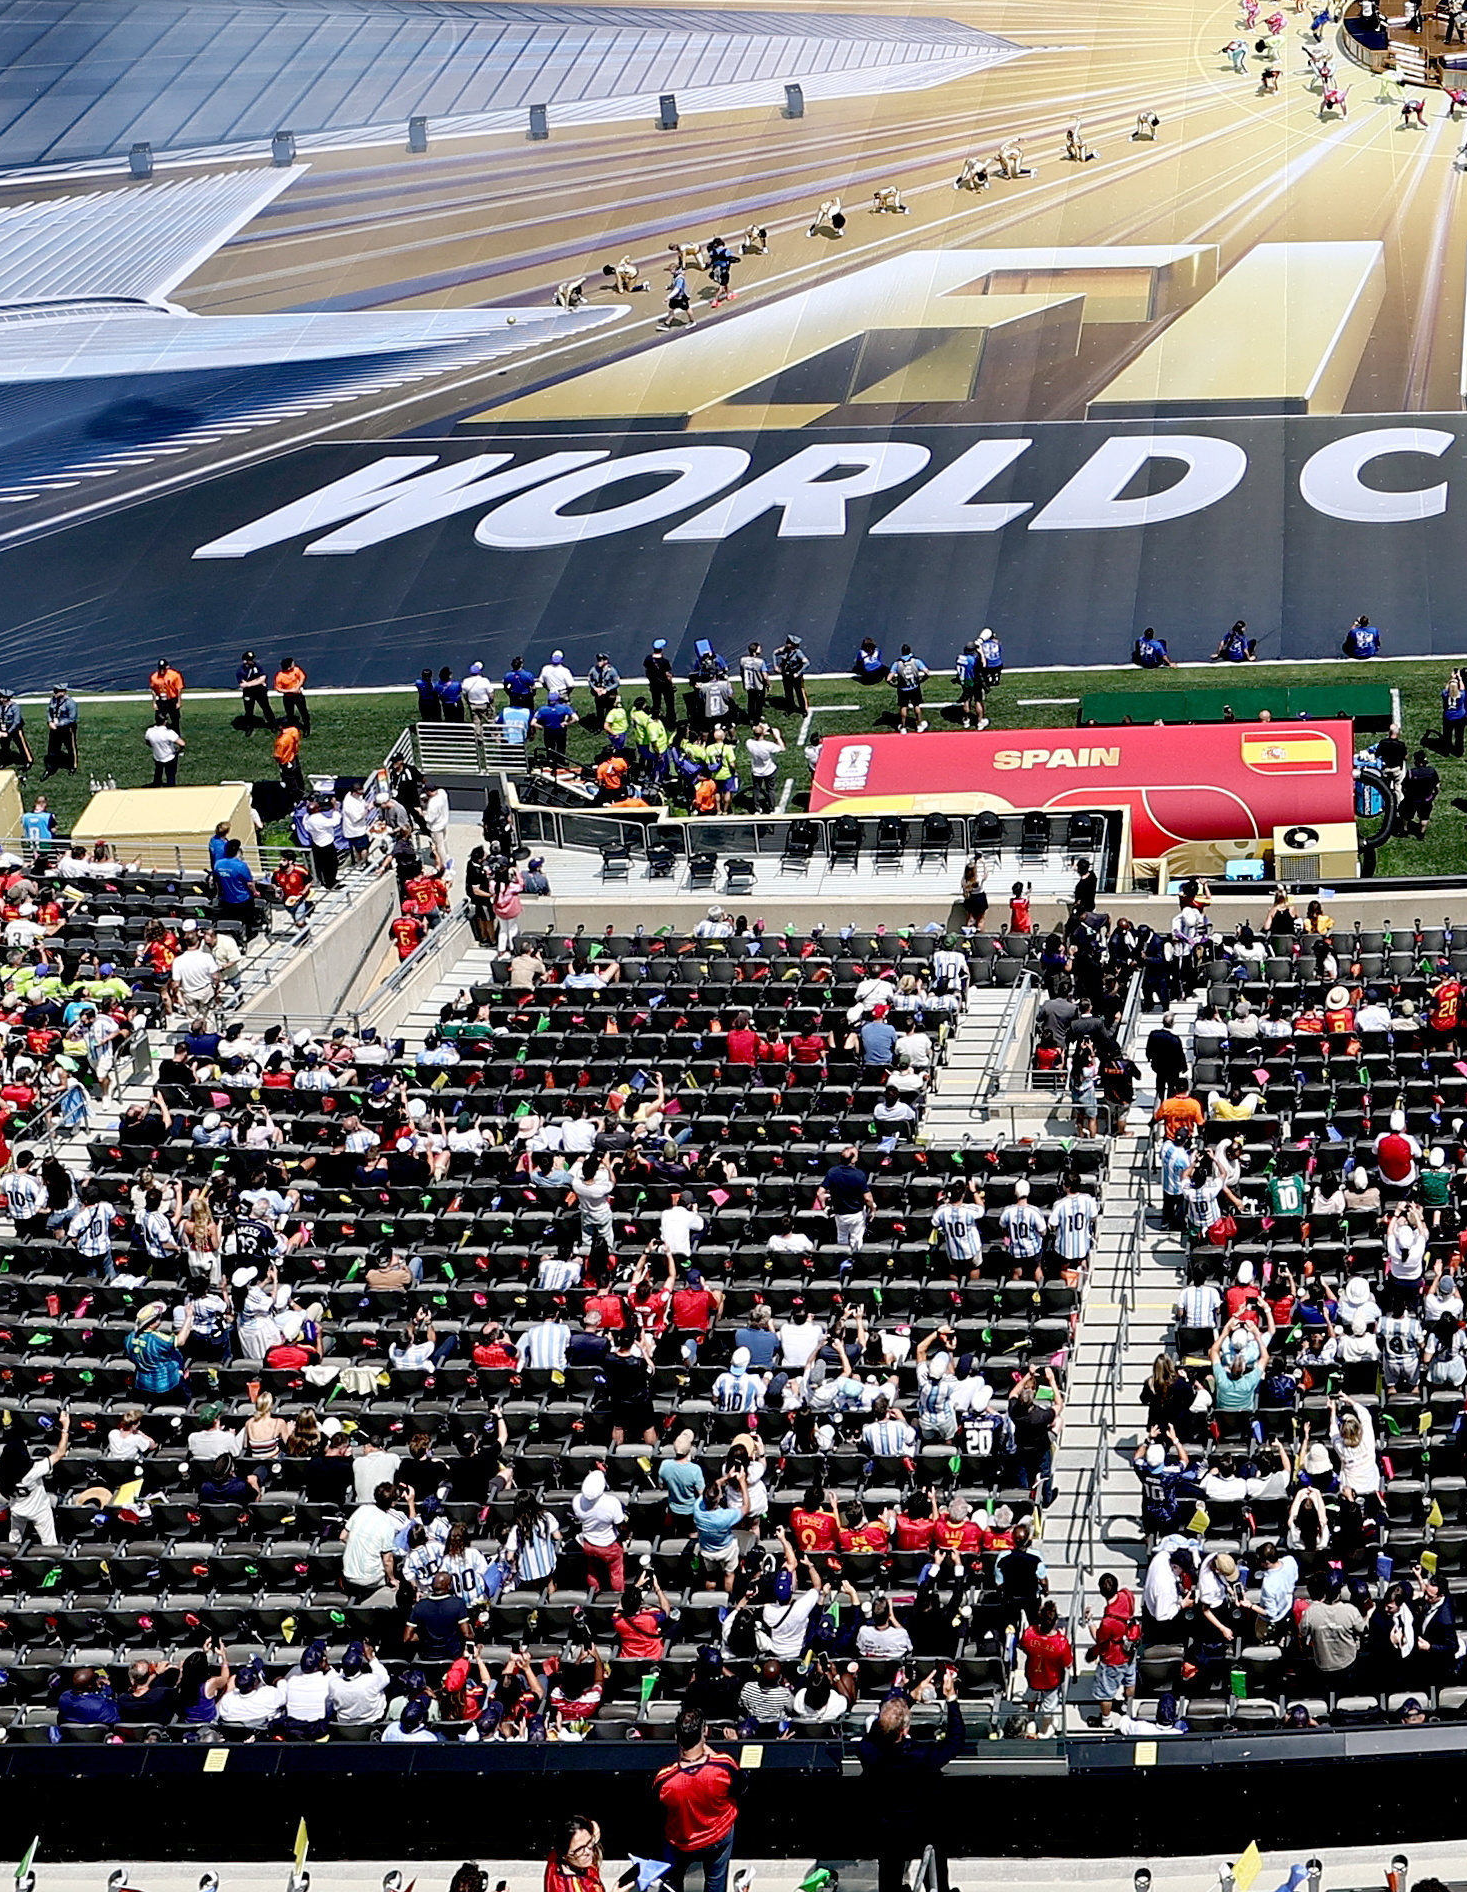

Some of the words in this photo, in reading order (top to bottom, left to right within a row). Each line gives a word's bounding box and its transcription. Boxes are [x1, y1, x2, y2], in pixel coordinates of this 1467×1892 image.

[192, 436, 1246, 558] WORLD
[992, 747, 1121, 771] SPAIN
[1278, 1187, 1298, 1209] 10
[947, 1221, 966, 1239] 10
[1012, 1221, 1030, 1239] 10
[1068, 1213, 1085, 1233] 10
[966, 1429, 993, 1455] 20
